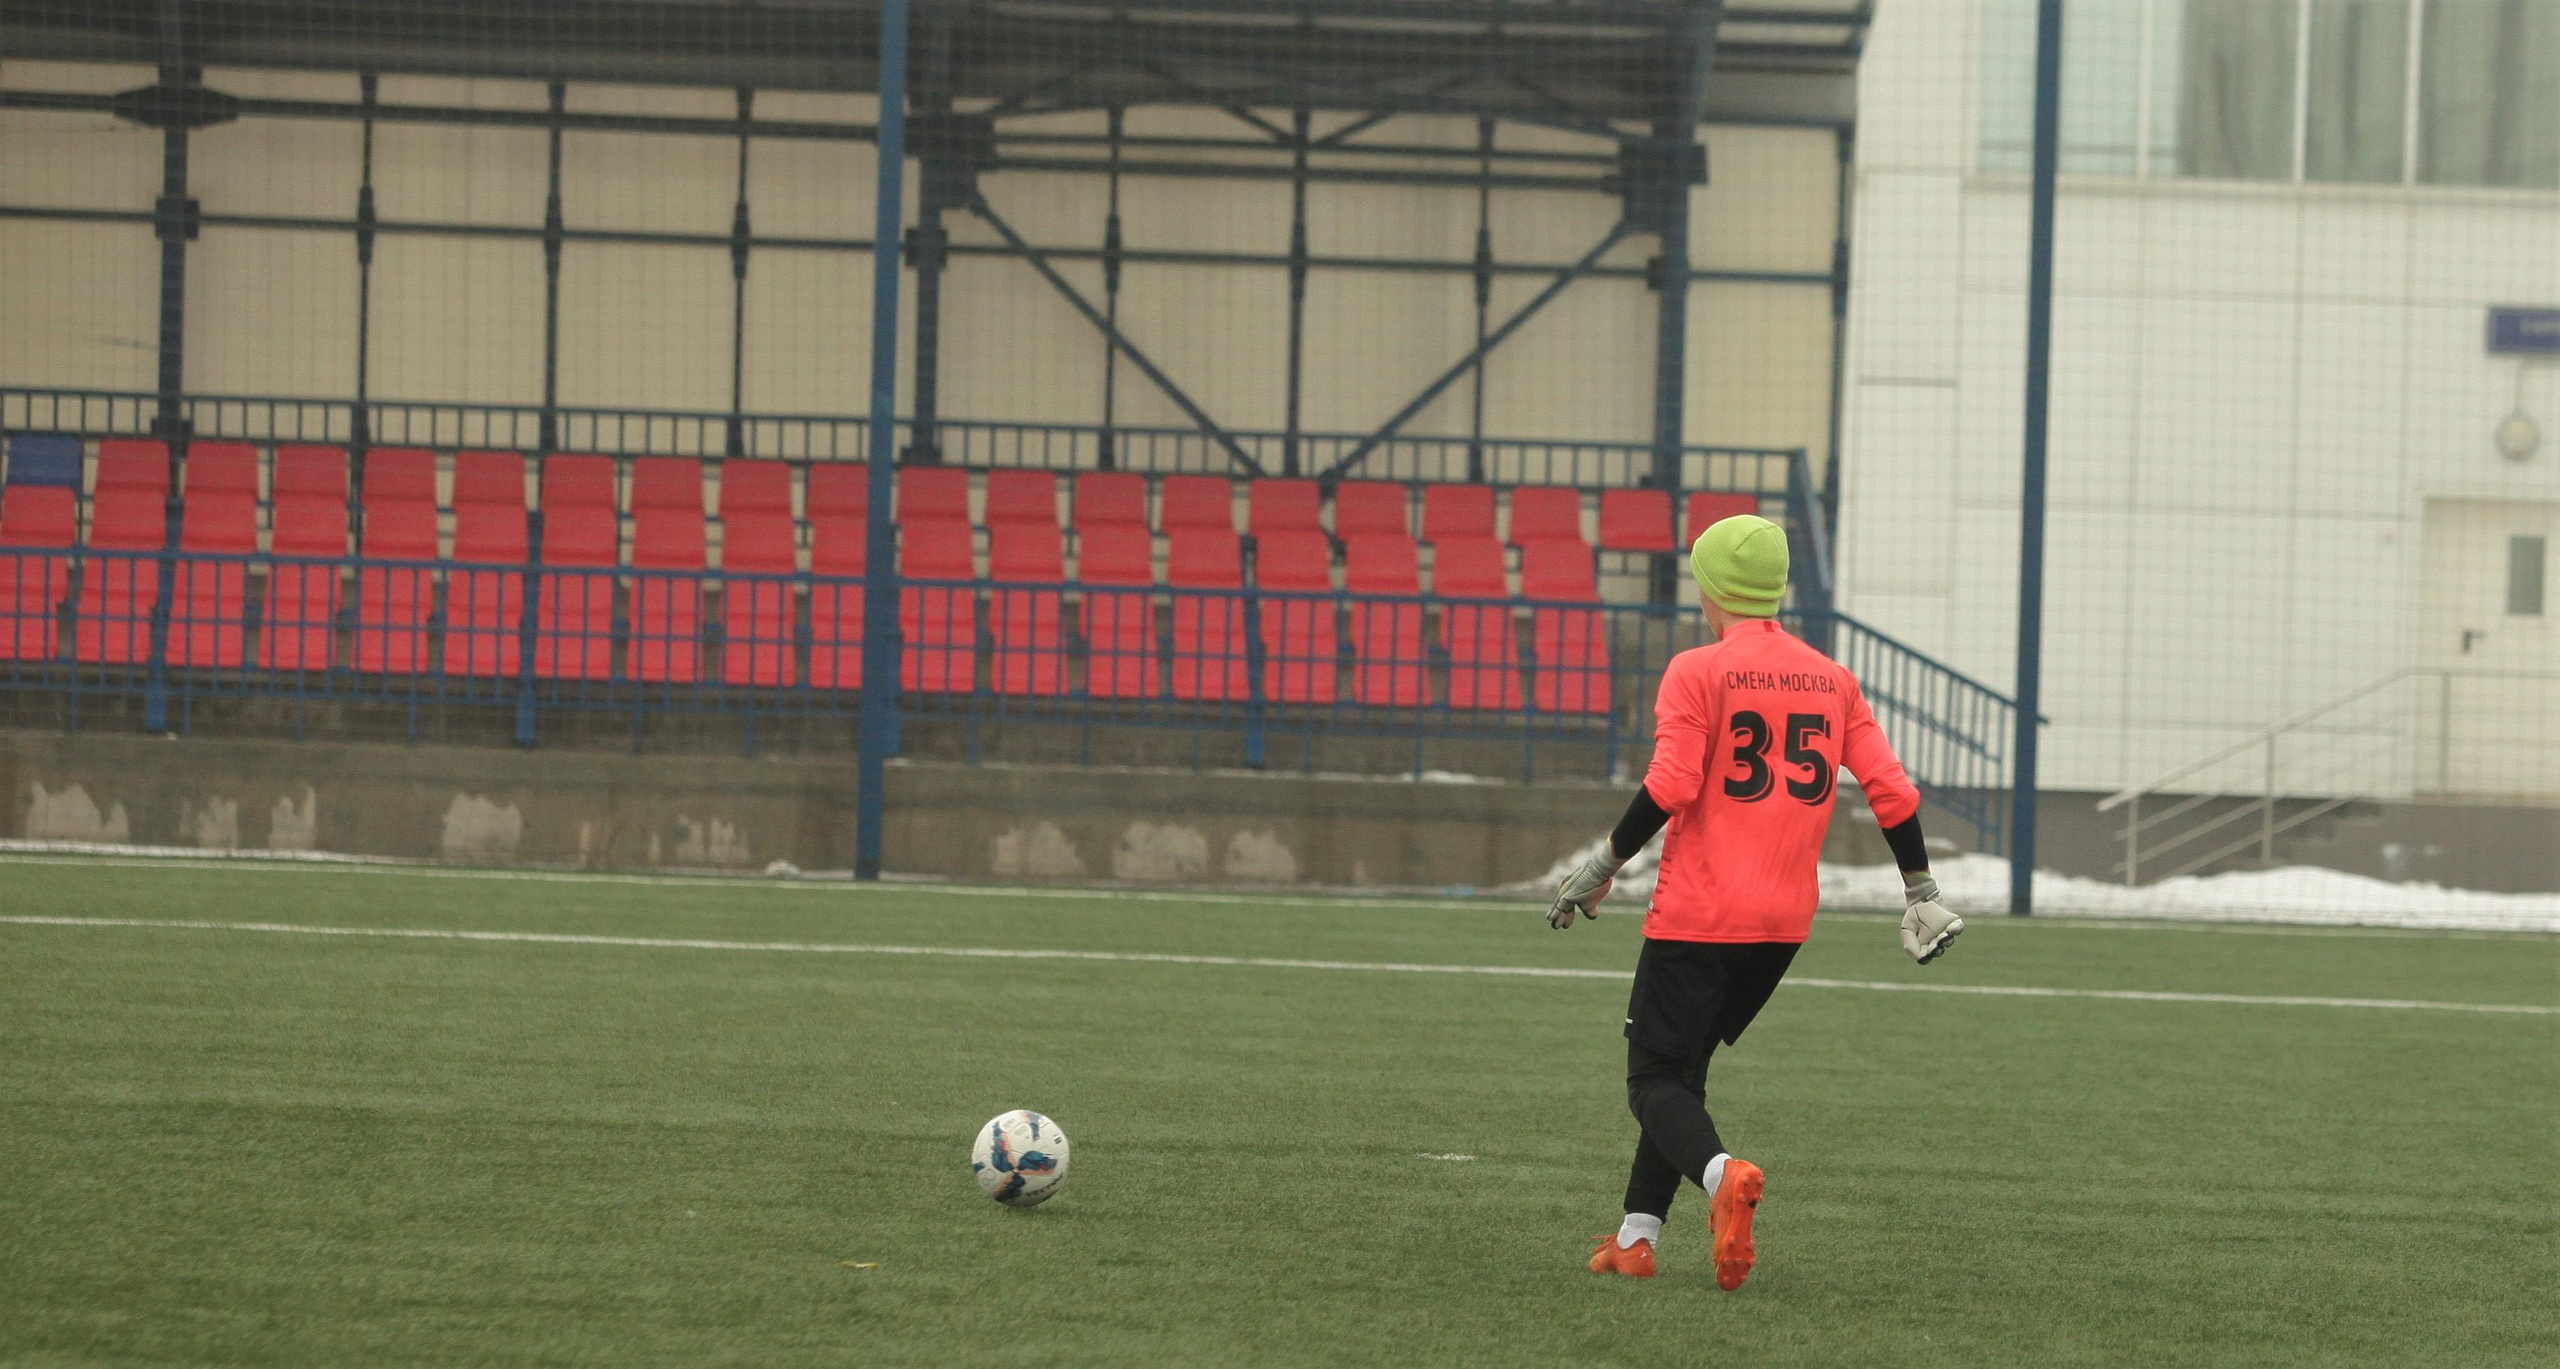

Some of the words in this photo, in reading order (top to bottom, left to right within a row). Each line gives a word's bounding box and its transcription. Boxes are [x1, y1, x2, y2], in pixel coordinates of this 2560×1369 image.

[1726, 671, 1776, 691] СМЕНА
[1779, 673, 1837, 695] МОСКВА
[1724, 710, 1833, 806] 35
